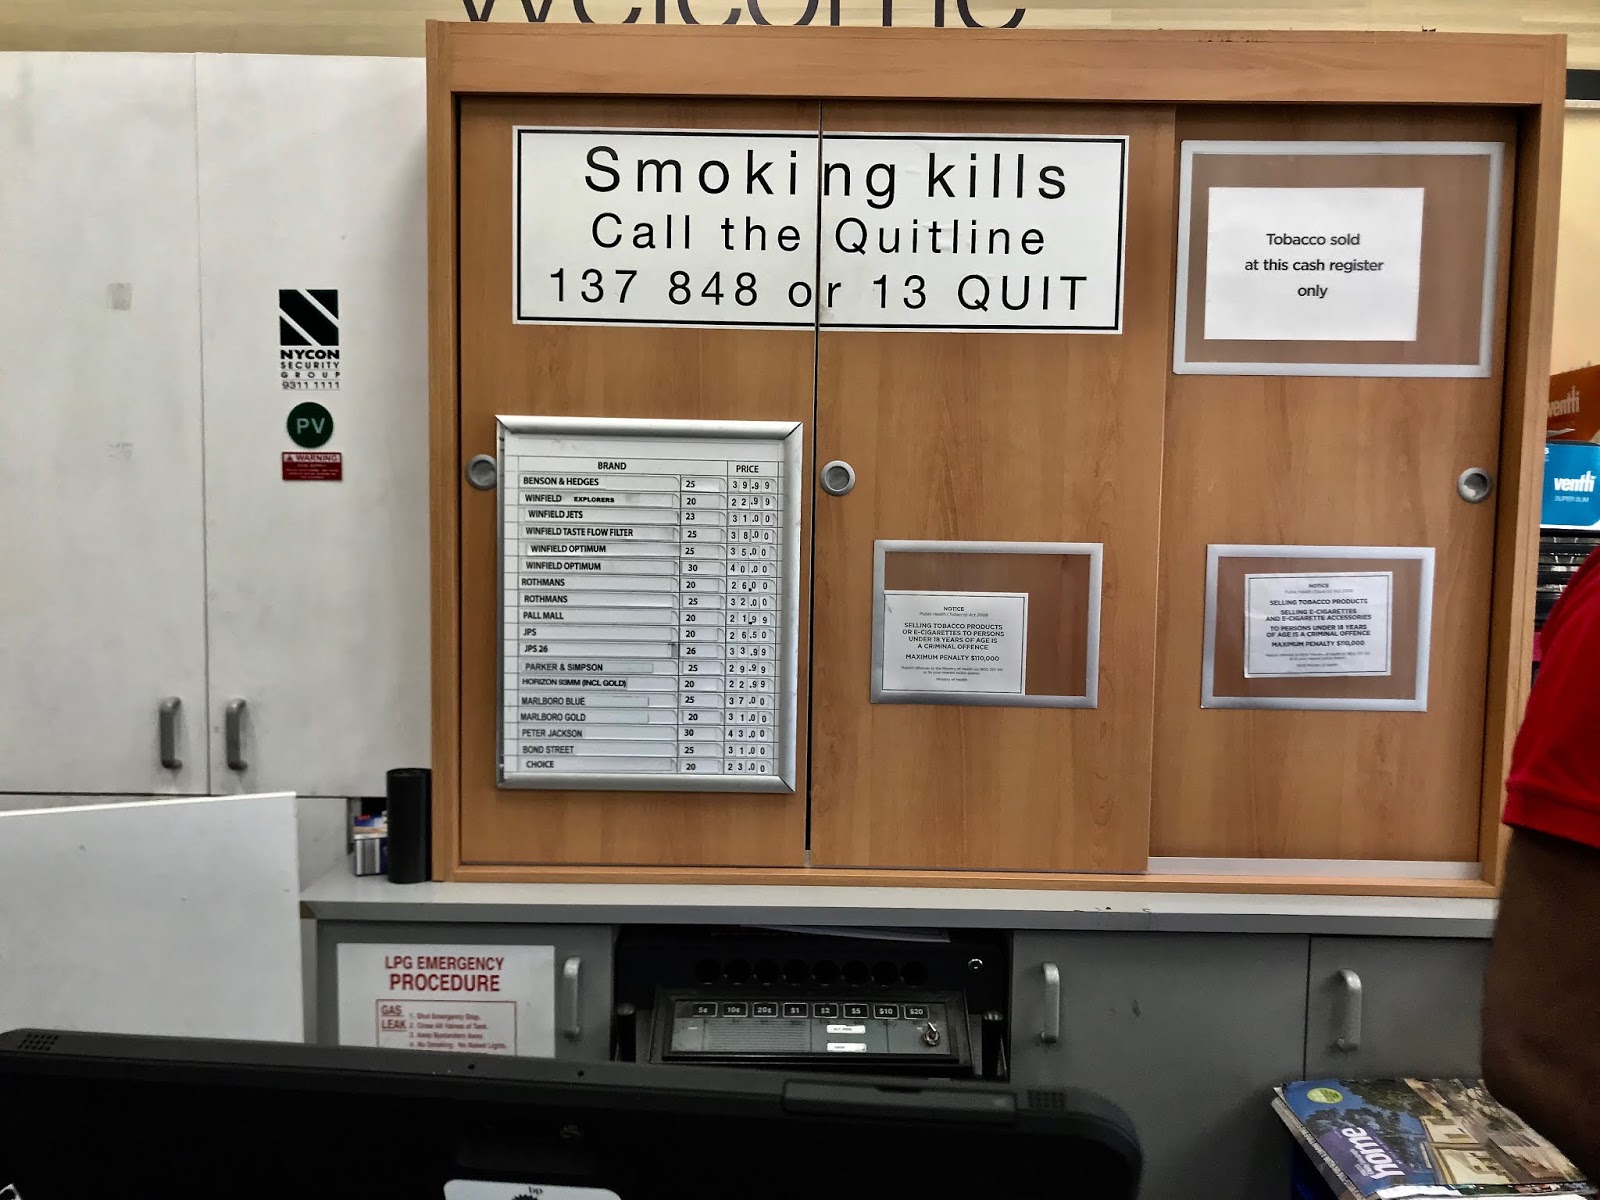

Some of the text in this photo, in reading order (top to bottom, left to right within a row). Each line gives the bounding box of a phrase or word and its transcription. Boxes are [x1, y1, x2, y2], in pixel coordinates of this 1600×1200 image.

[584, 146, 1066, 208] Smoking kills
[592, 213, 1046, 256] Call the Quitline
[1267, 233, 1360, 246] Tobacco sold
[1245, 260, 1384, 273] at this cash register
[550, 268, 1088, 312] 137 848 or 13 QUIT
[1298, 285, 1328, 299] only
[280, 350, 340, 359] NYCON
[297, 418, 325, 434] PV
[598, 462, 627, 470] BRAND
[736, 465, 759, 473] PRICE
[524, 477, 557, 485] BENSON
[567, 478, 599, 486] HEDGES
[528, 510, 565, 518] WINFIELD
[526, 527, 562, 535] WINFIELD
[587, 528, 609, 536] FLOW
[564, 562, 601, 570] OPTIMUM
[522, 578, 565, 586] ROTHMANS
[524, 595, 568, 603] ROTHMANS
[542, 612, 563, 620] MALL
[525, 663, 557, 671] PARKER
[567, 663, 603, 671] SIMPSON
[522, 697, 563, 705] MARLBORO
[521, 713, 563, 721] MARLBORO
[522, 729, 546, 737] PETER
[546, 746, 574, 754] STREET
[384, 956, 504, 971] LPG EMERGENCY
[389, 973, 500, 991] PROCEDURE
[381, 1005, 402, 1015] GAS
[381, 1020, 406, 1029] LEAK
[1342, 1128, 1405, 1179] home
